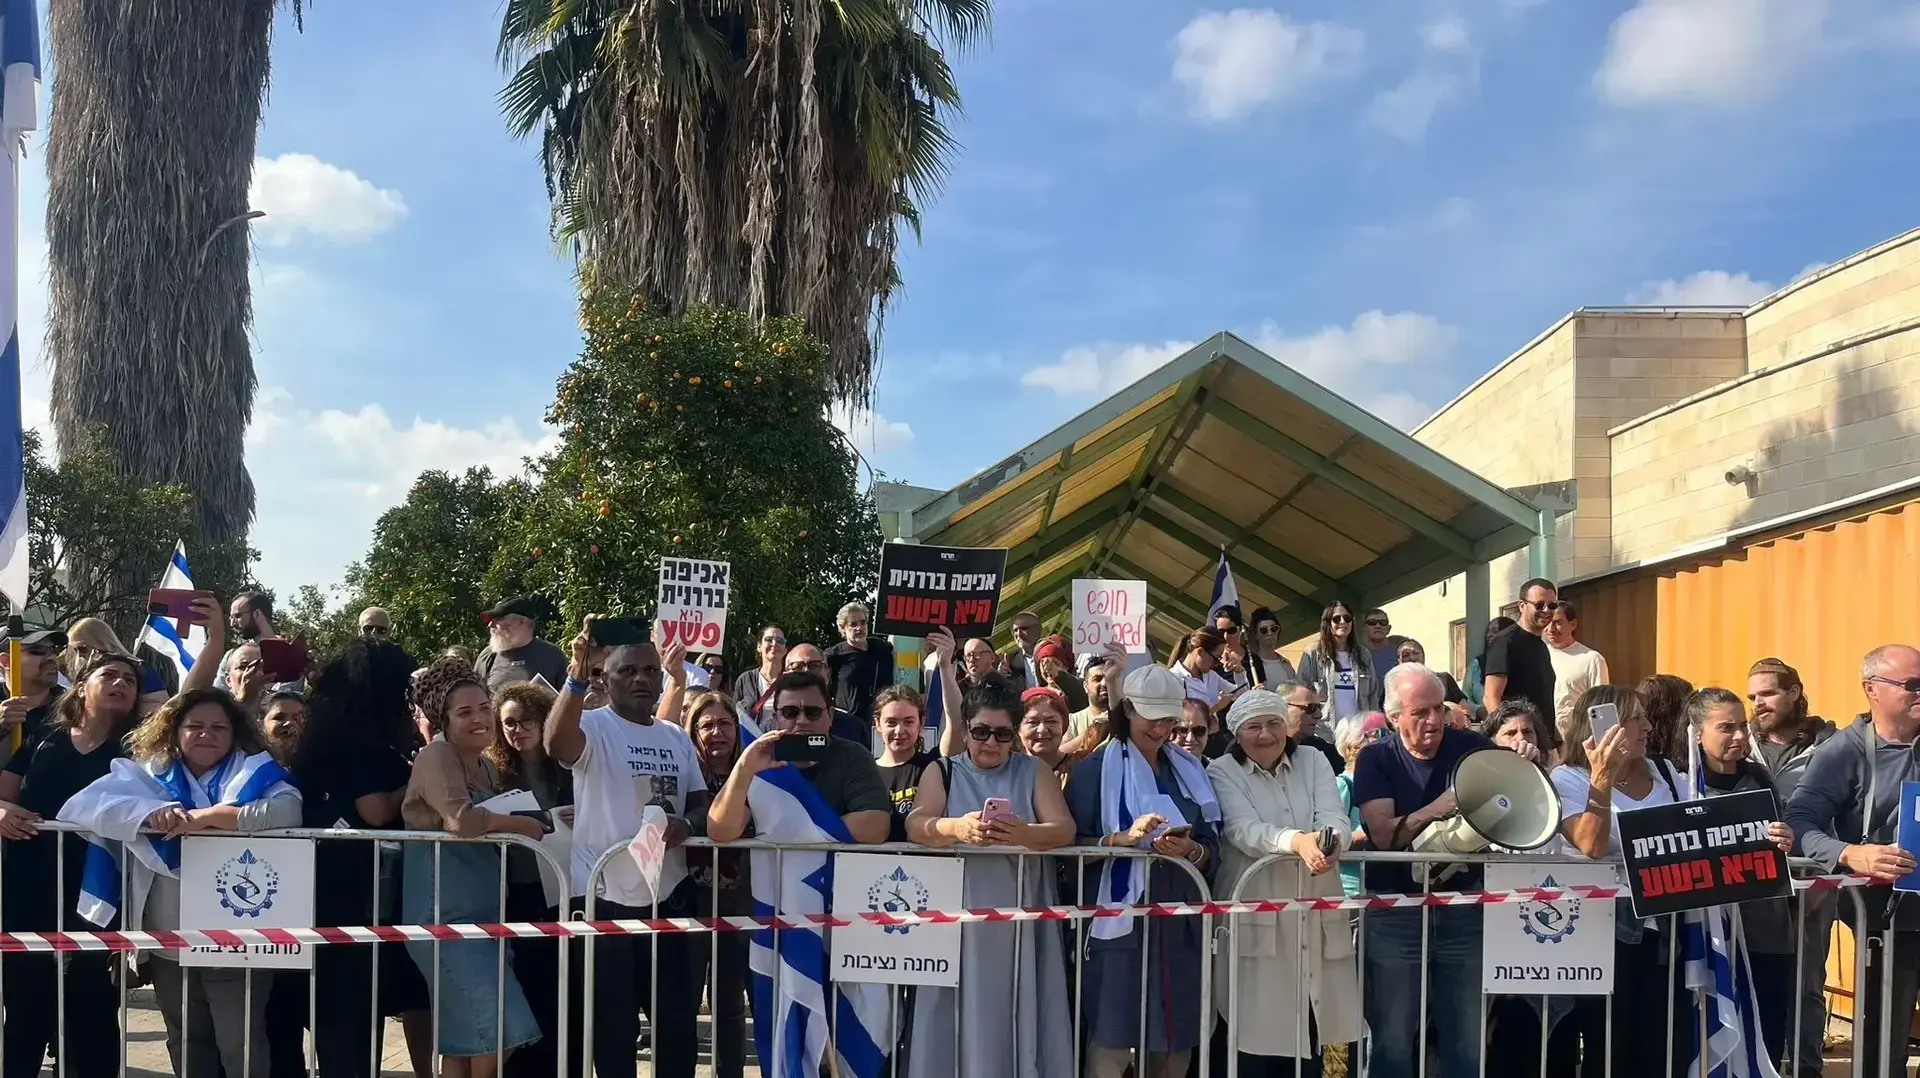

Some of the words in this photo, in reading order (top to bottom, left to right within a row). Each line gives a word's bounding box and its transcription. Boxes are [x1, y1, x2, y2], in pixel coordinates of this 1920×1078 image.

[663, 560, 727, 584] אכיפה
[888, 568, 946, 591] בררנית
[950, 573, 997, 591] אכיפה
[661, 584, 725, 608] בררנית
[1087, 589, 1128, 616] חופש
[680, 609, 703, 622] היא
[885, 594, 948, 624] פשע
[953, 599, 992, 624] היא
[661, 620, 721, 648] פשע
[627, 745, 657, 756] רפאל
[627, 760, 657, 772] הפקר
[660, 763, 680, 772] אינו
[1632, 830, 1702, 859] בררנית
[1705, 820, 1770, 847] אכיפה
[1638, 859, 1714, 898] פשע
[1720, 850, 1778, 885] היא
[842, 954, 896, 970] נציבות
[904, 957, 949, 973] מחנה
[1494, 965, 1549, 980] נציבות
[1557, 966, 1603, 980] מחנה
